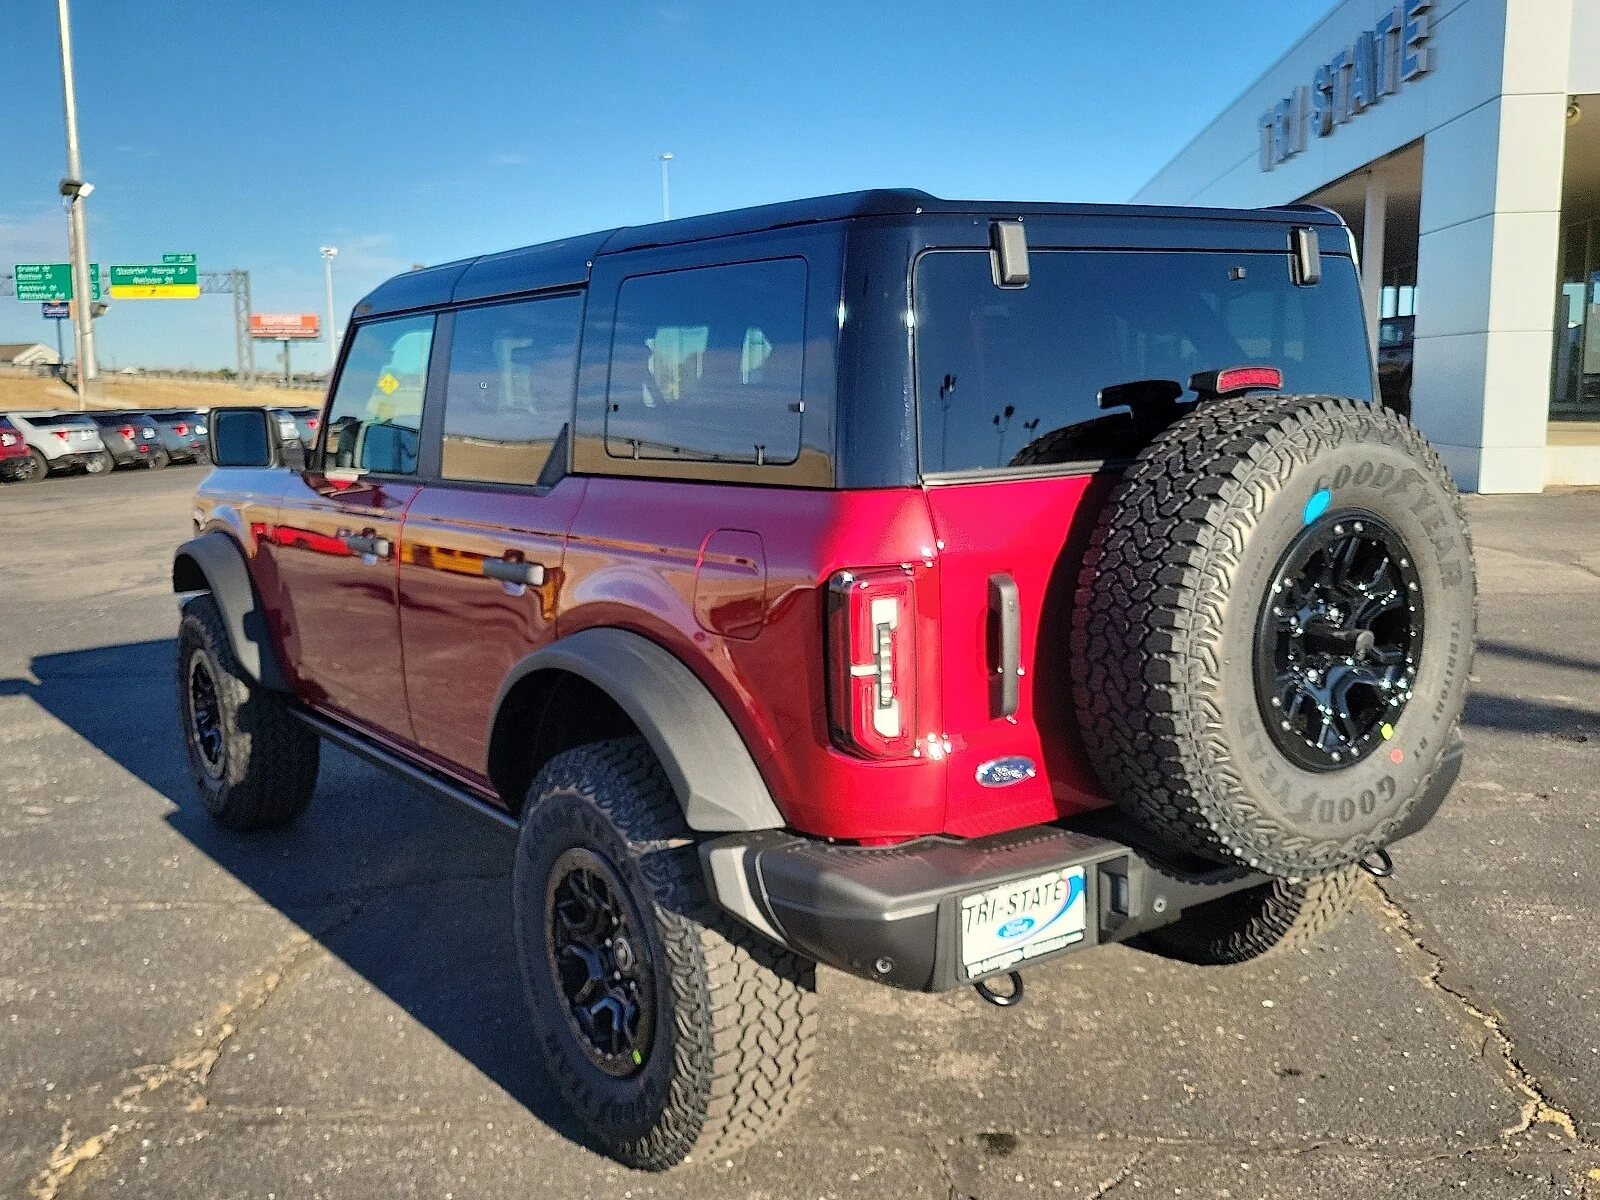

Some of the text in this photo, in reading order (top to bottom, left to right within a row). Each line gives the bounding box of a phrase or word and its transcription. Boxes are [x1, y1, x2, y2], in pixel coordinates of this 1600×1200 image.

[1257, 0, 1432, 172] TRI STATE
[962, 879, 1063, 935] TRI-STATE
